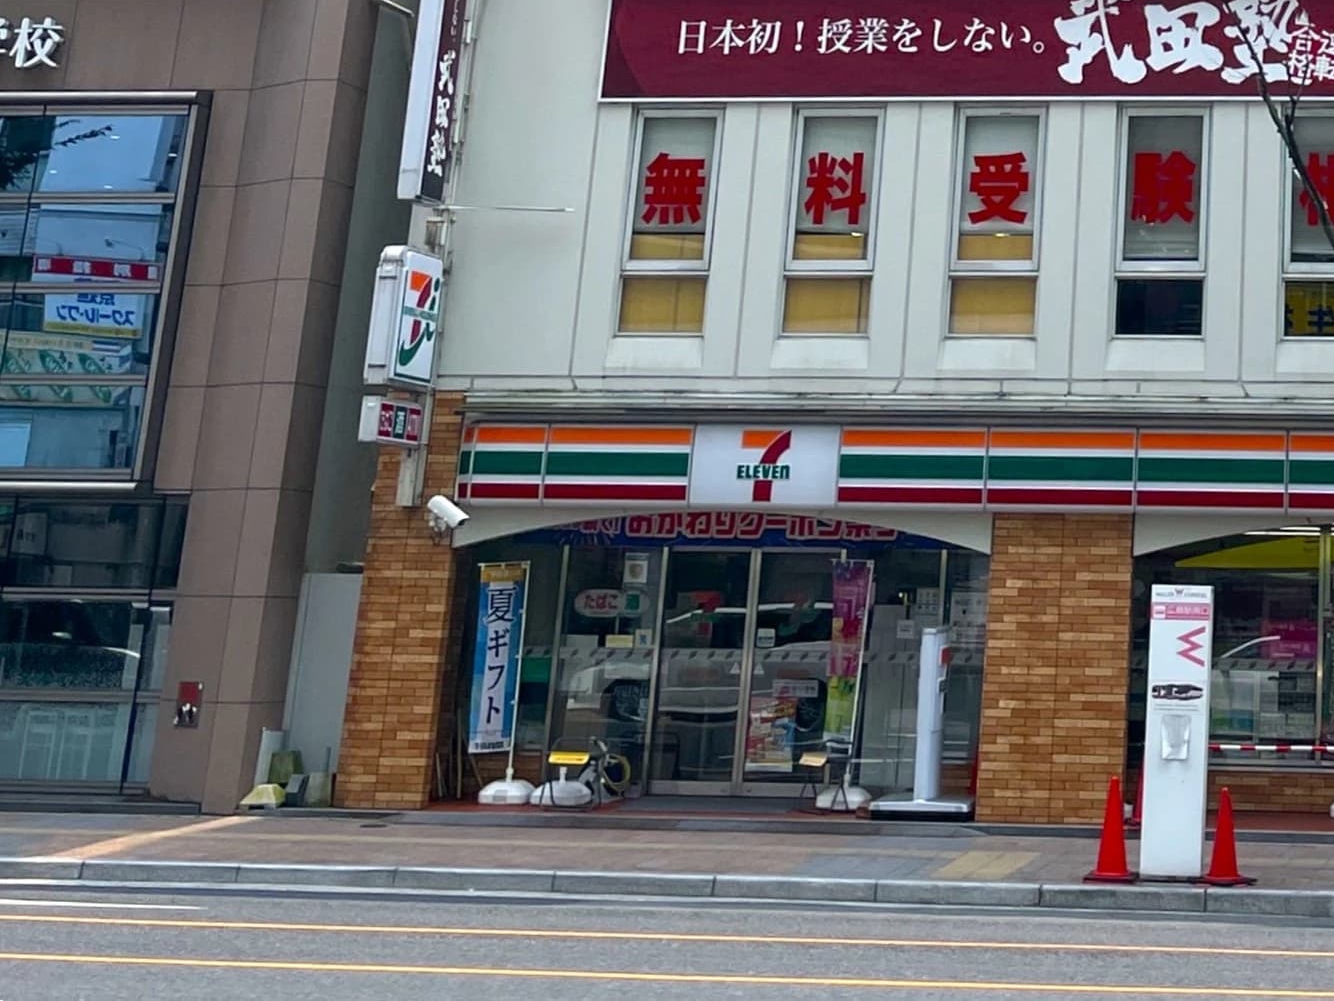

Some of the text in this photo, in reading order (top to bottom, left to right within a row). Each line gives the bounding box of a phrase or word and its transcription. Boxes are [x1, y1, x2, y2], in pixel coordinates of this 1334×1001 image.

[0, 16, 66, 68] 校
[486, 585, 517, 725] 夏ギフト
